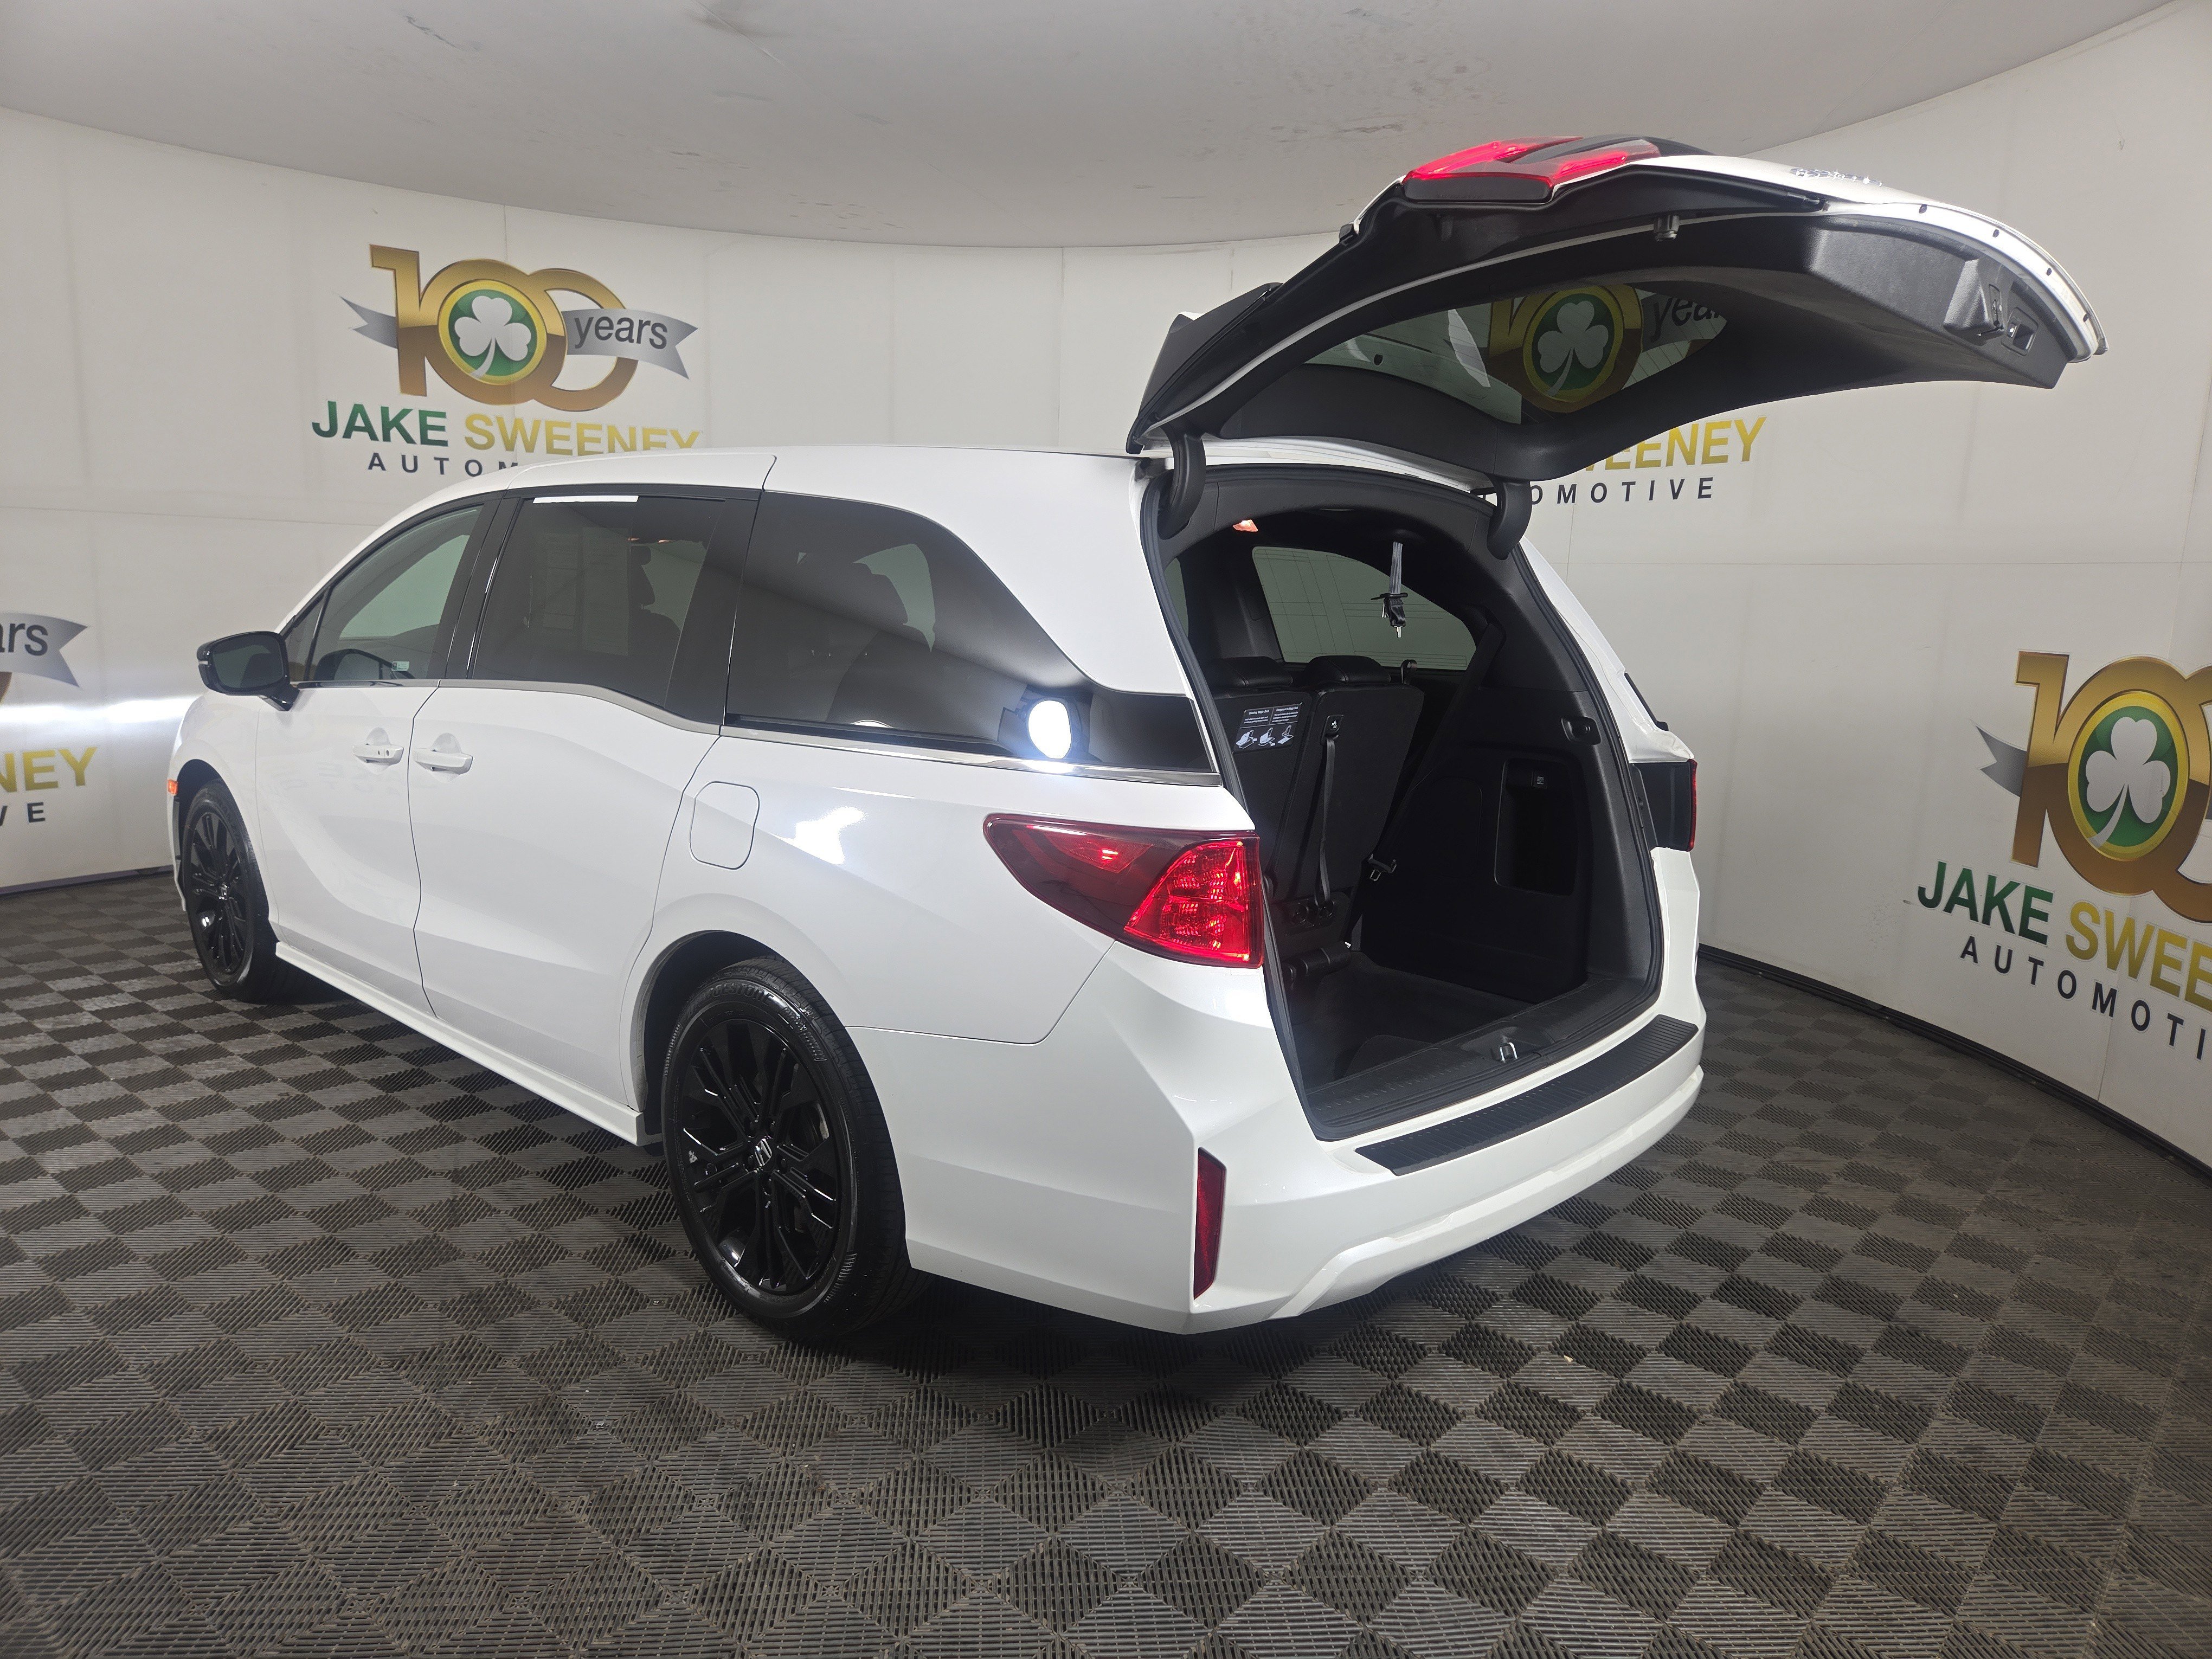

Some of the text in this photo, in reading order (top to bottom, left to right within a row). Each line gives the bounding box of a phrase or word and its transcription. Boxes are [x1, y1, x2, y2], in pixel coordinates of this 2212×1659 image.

[369, 244, 667, 412] 100 years
[1651, 297, 1720, 343] yea
[312, 400, 449, 447] JAKE
[1917, 860, 2212, 1013] JAKE SWEE
[1959, 935, 2207, 1060] AUTOMOTI
